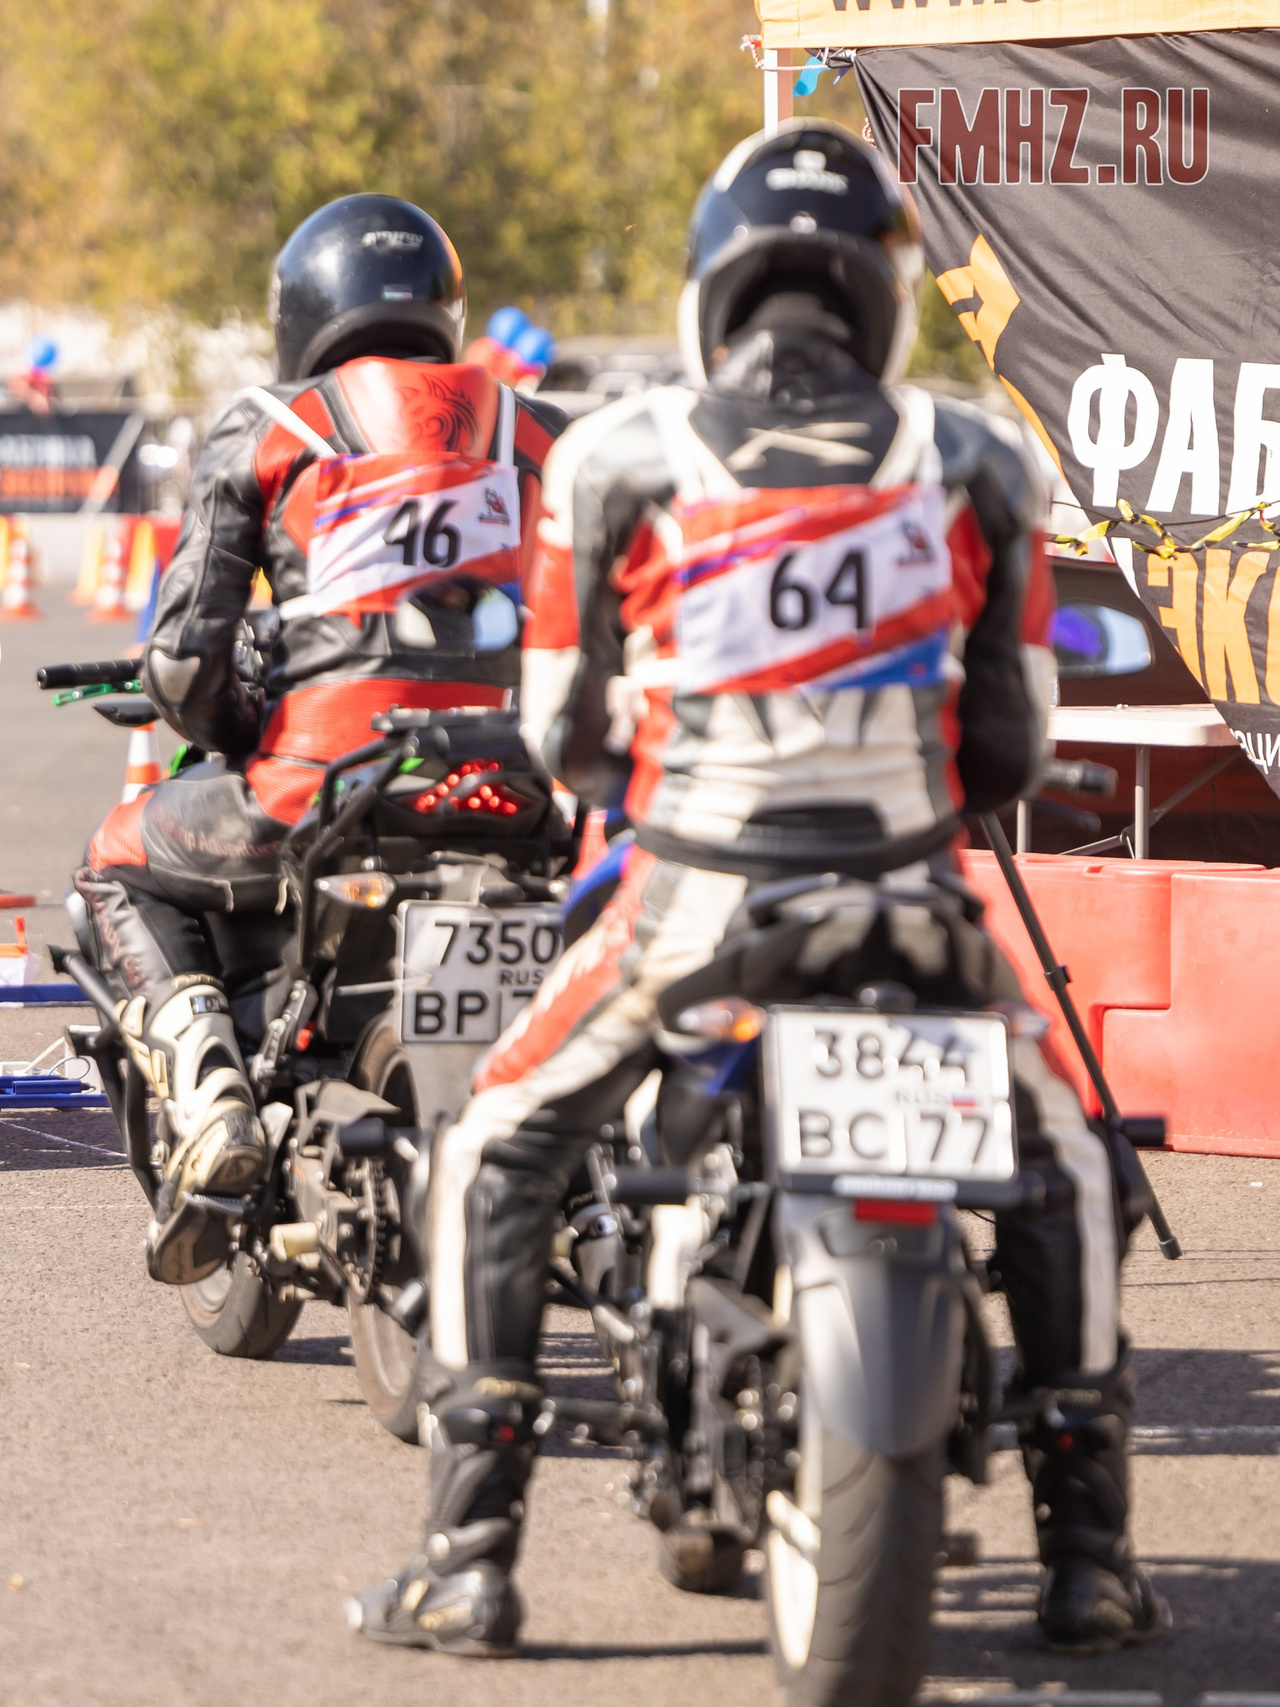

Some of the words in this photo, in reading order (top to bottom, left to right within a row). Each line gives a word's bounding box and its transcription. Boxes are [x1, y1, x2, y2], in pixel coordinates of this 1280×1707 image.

[382, 498, 462, 569] 46
[768, 544, 872, 632] 64
[434, 919, 561, 967] 7350
[499, 969, 545, 986] RUS
[811, 1027, 972, 1087] 3844
[918, 1113, 988, 1165] 77
